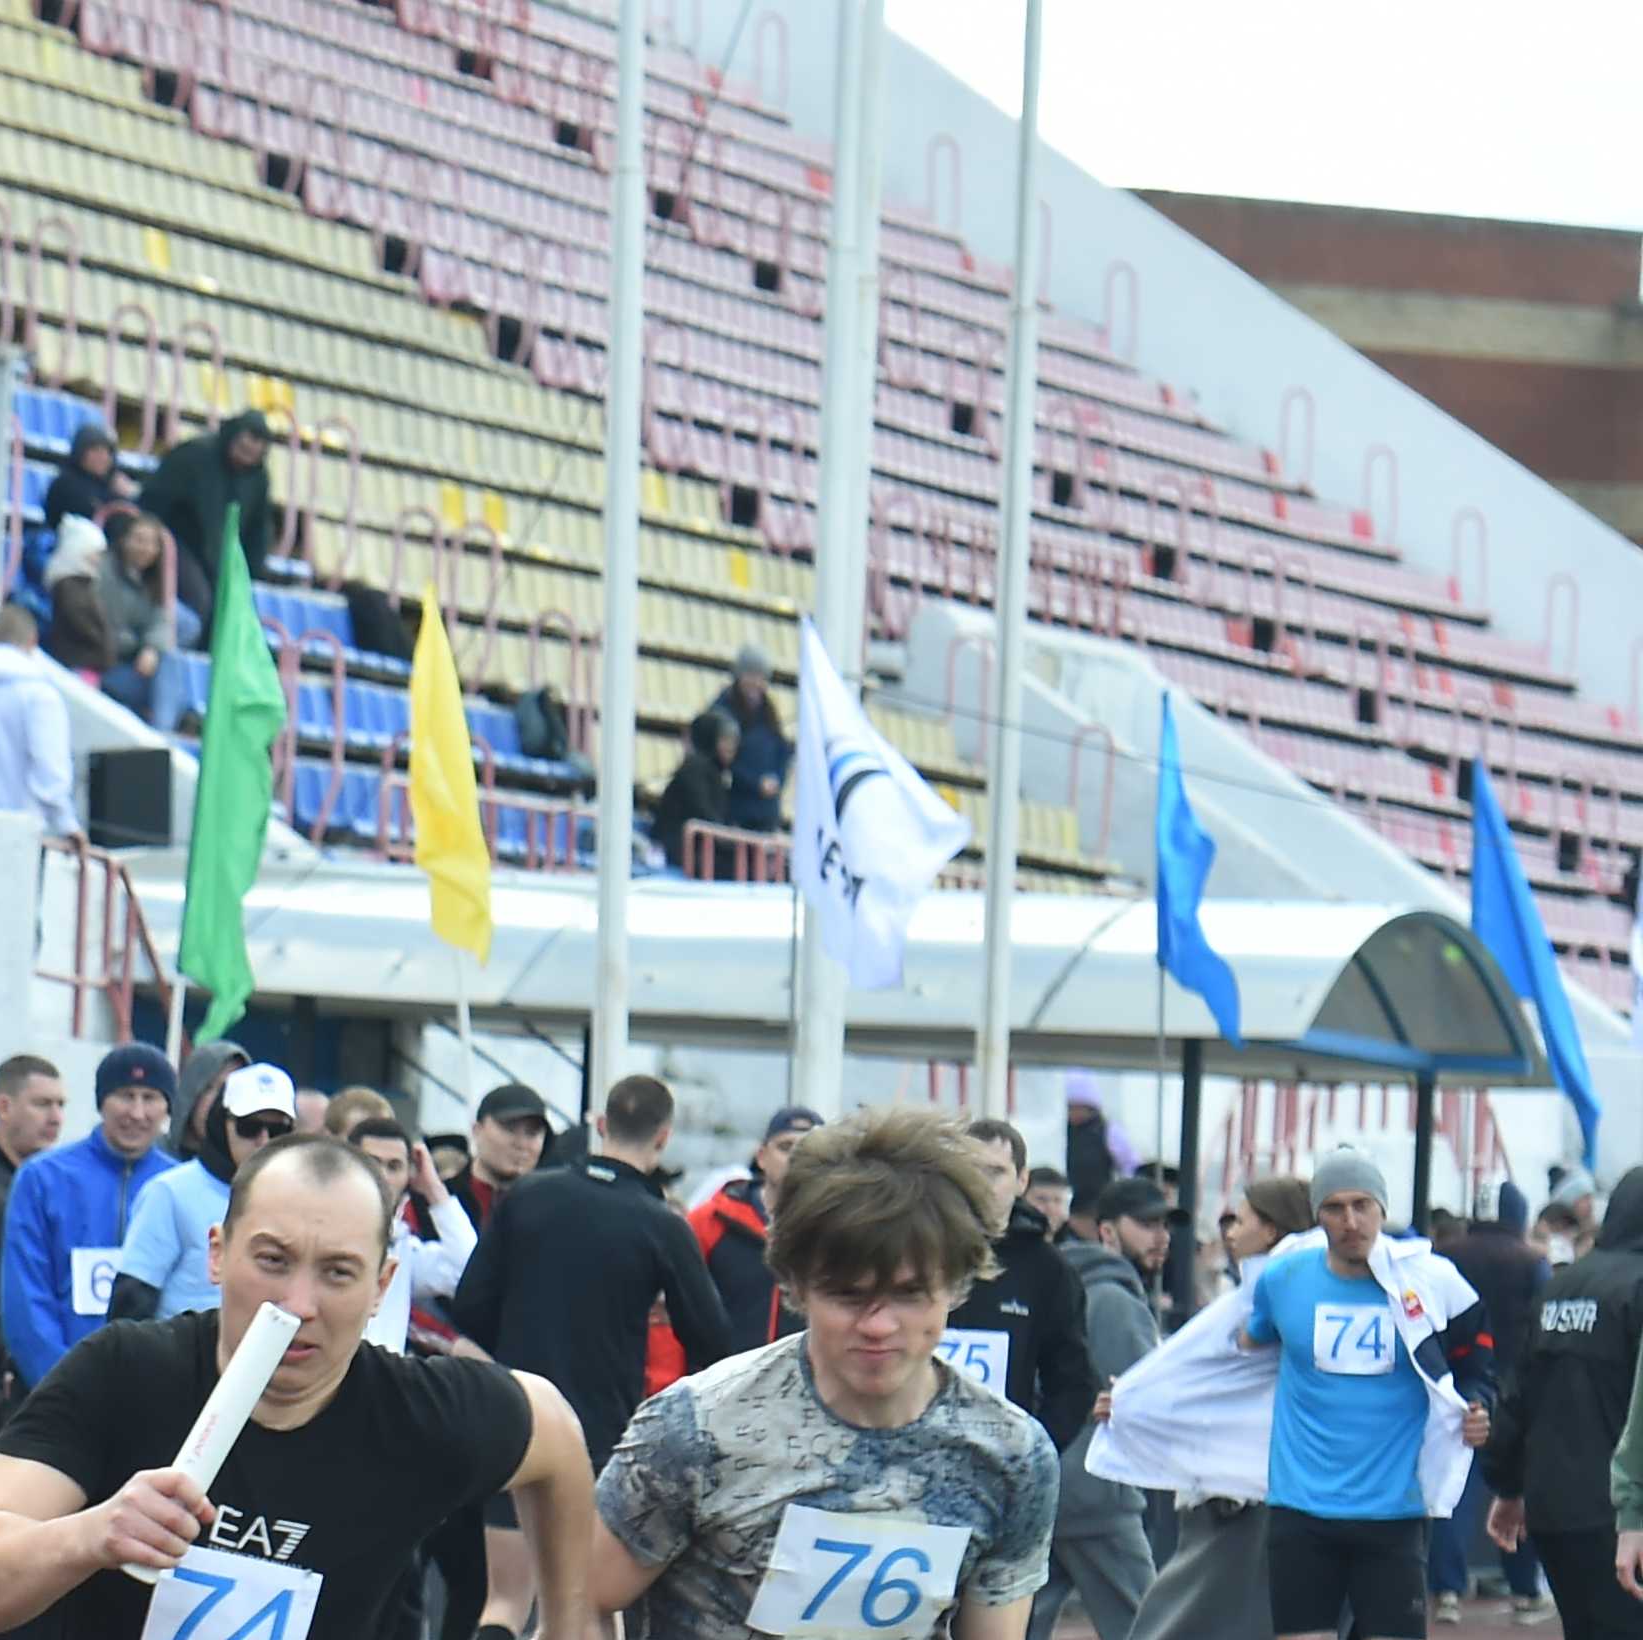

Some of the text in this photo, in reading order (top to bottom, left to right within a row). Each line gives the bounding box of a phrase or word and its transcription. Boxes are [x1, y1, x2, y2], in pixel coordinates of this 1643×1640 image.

[90, 1260, 115, 1303] 6
[1325, 1315, 1387, 1359] 74
[209, 1504, 311, 1560] EA7
[800, 1538, 932, 1629] 76
